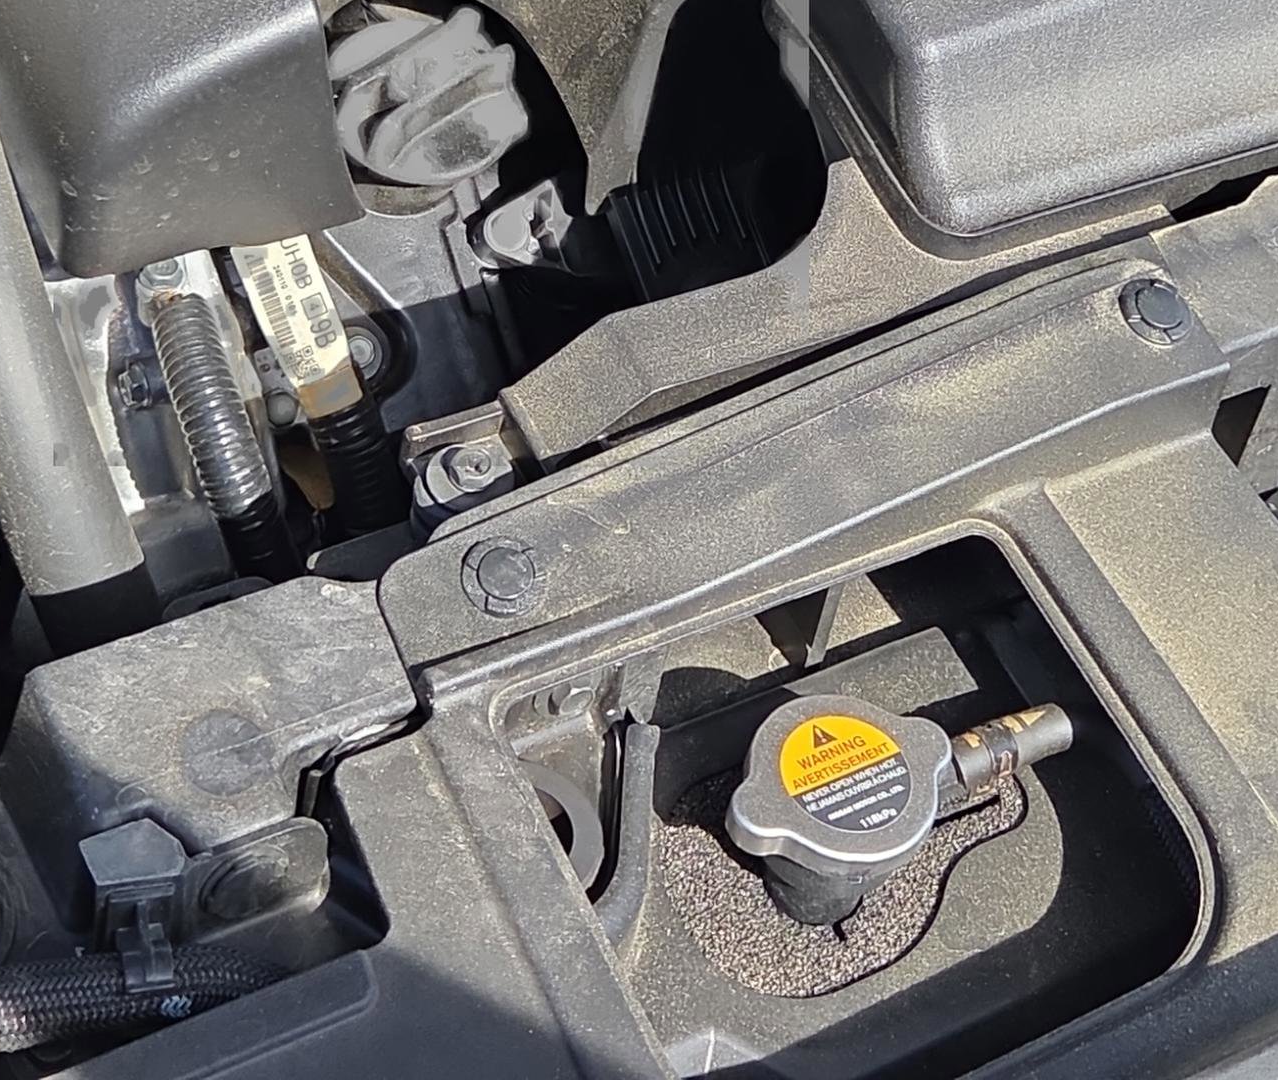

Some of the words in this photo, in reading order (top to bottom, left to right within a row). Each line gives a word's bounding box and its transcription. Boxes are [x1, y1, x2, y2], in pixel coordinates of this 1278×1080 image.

[309, 318, 338, 349] 9B
[792, 742, 891, 790] AVERTISSEMENT
[797, 735, 866, 770] WARNING
[802, 787, 832, 803] NEVER
[830, 778, 854, 791] OPEN
[853, 767, 880, 783] WHEN
